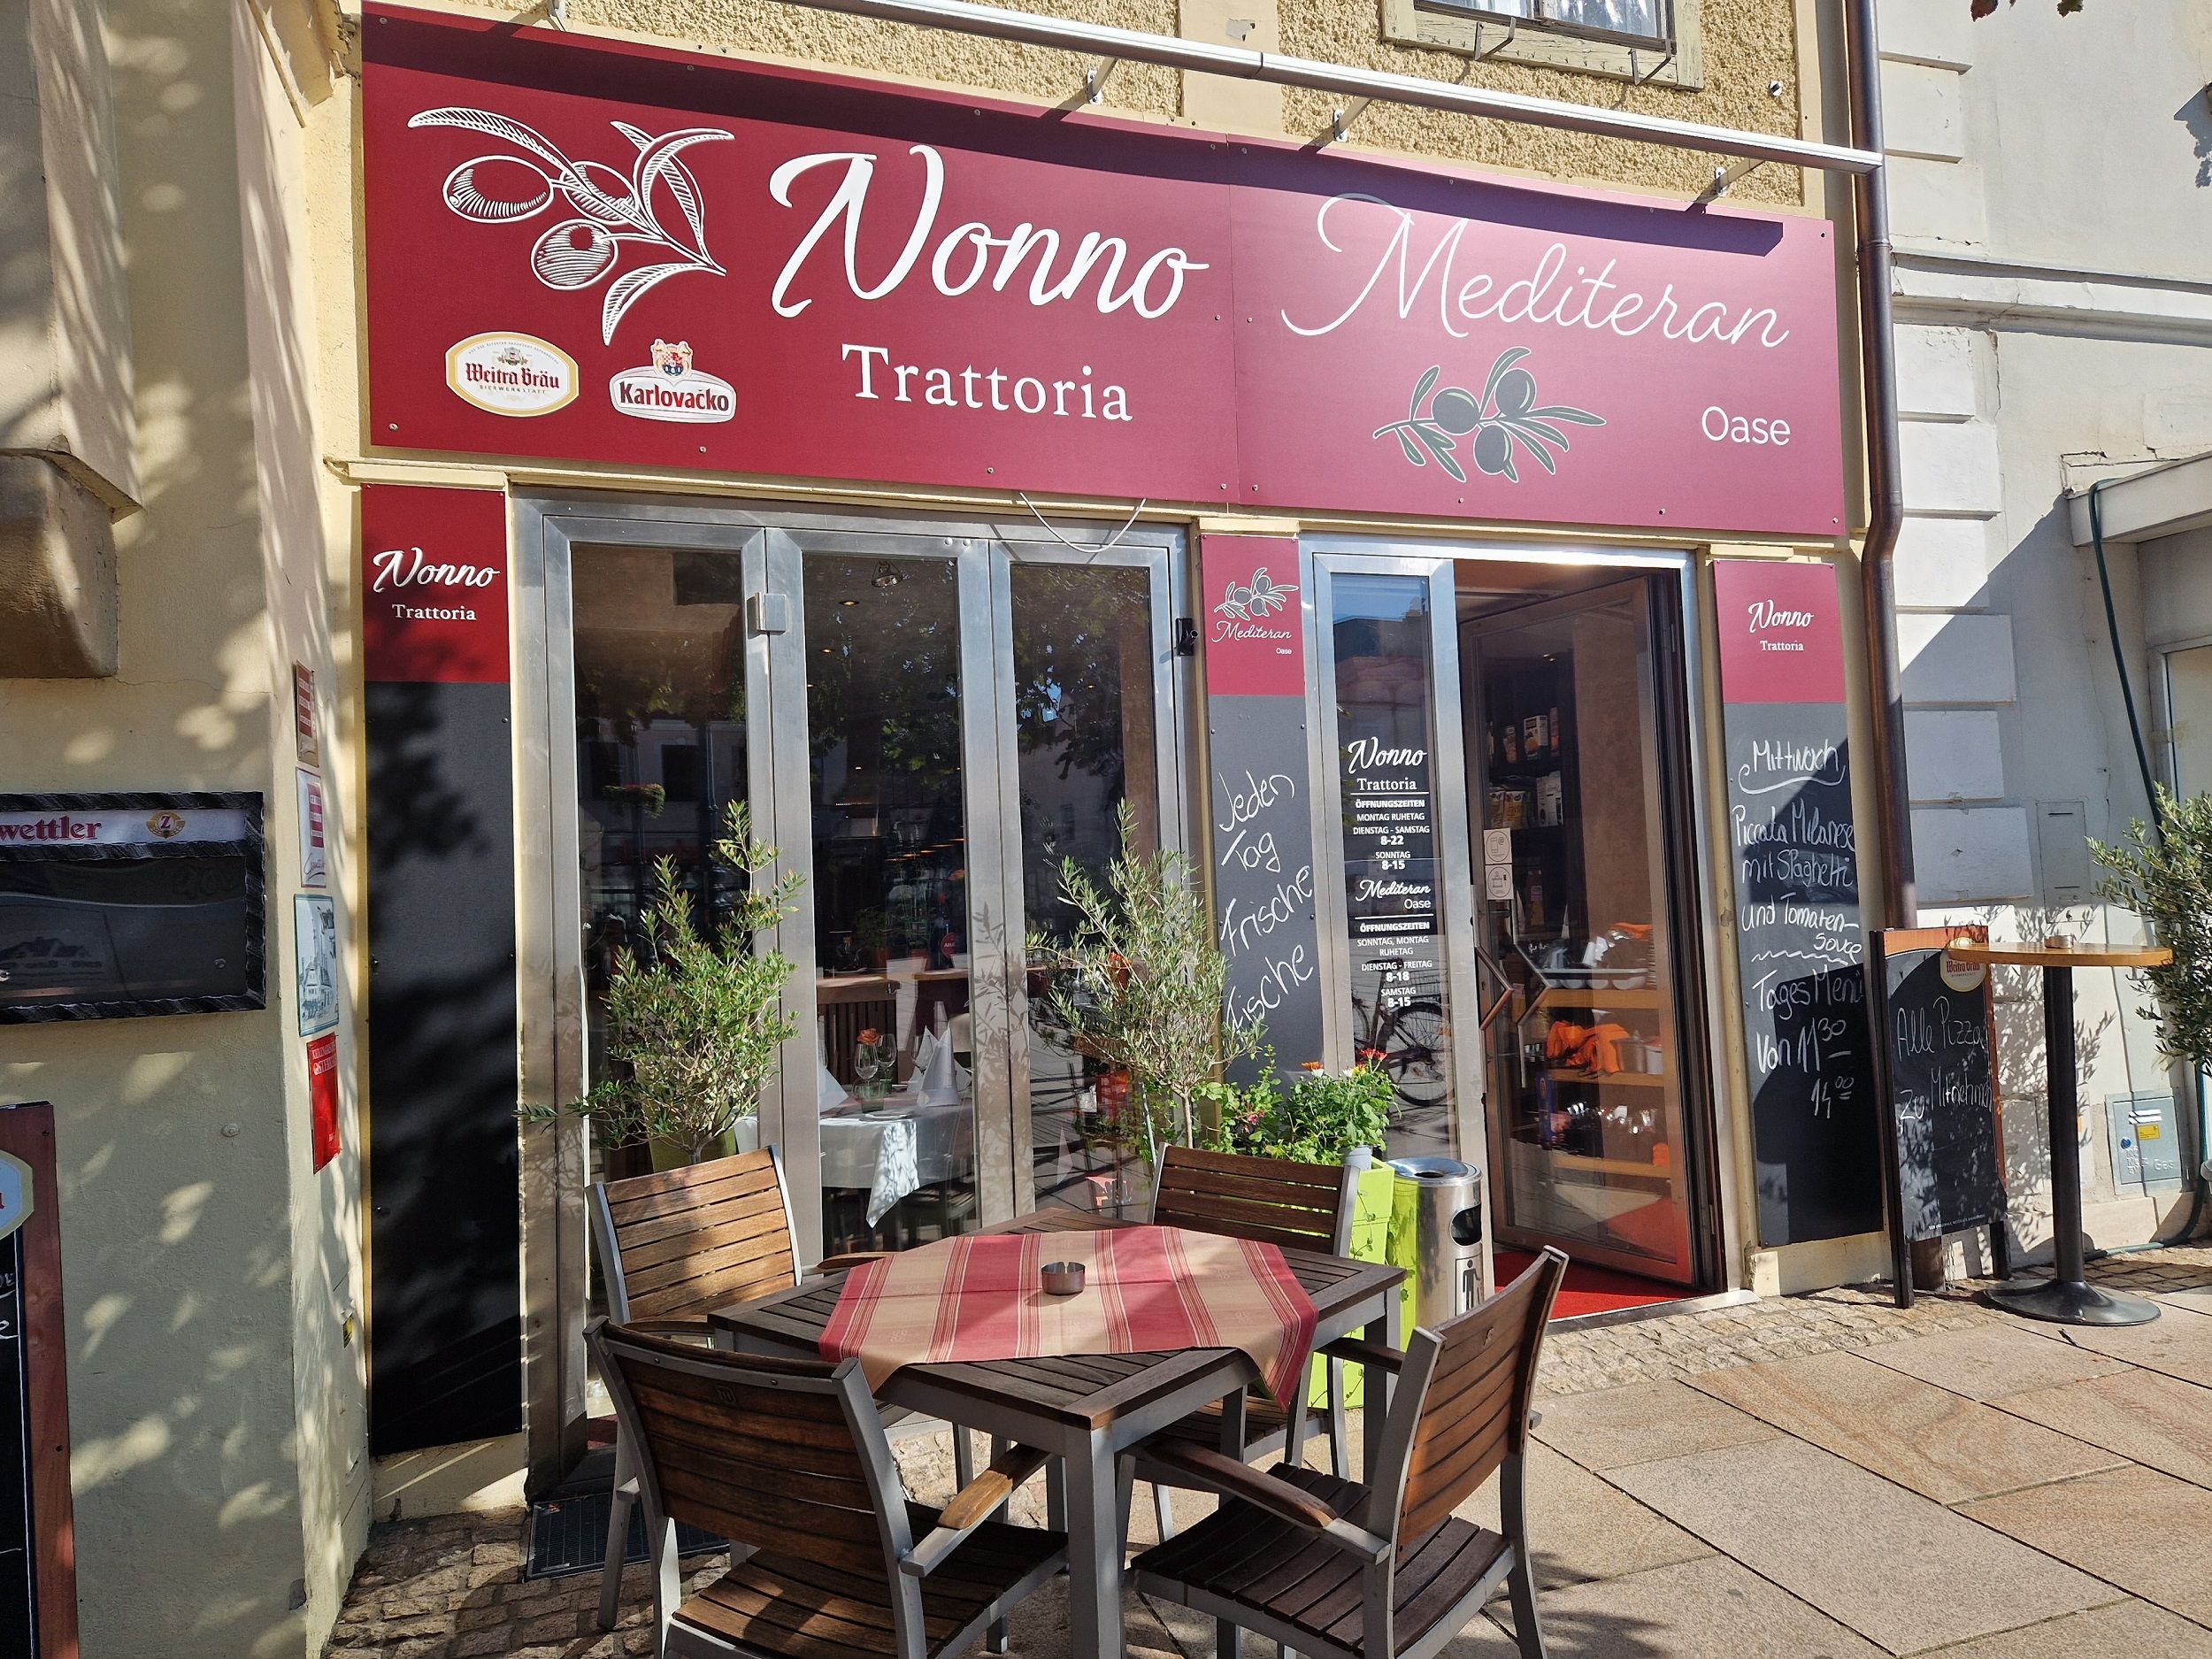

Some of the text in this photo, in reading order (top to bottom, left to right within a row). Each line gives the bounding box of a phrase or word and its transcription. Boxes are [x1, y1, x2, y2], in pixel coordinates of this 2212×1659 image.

[768, 144, 1210, 319] Nonno
[1280, 192, 1790, 349] Mediteran
[465, 362, 560, 390] Weitra Bräu
[841, 342, 1133, 423] Trattoria
[479, 385, 547, 395] BIERWERKSTATT
[619, 381, 730, 412] Karlovačko
[1701, 405, 1791, 447] Oase
[373, 547, 501, 593] Nonno
[392, 603, 477, 621] Trattoria
[1747, 599, 1815, 634] Nonno
[1211, 620, 1292, 642] Mediteran
[1760, 640, 1805, 651] Trattoria
[1348, 736, 1427, 774] Nonno
[1753, 739, 1839, 772] Mittwoch
[1357, 777, 1417, 791] Trattoria
[1217, 770, 1294, 833] Jeden
[1356, 799, 1425, 809] ÖFFNUNGSZEITEN
[1356, 812, 1425, 822] MONTAG RUHETAG
[1353, 826, 1389, 835] DIENSTAG
[1395, 826, 1430, 834] SAMSTAG
[1380, 835, 1404, 846] 8-22
[1221, 829, 1280, 873] Tag
[1375, 850, 1411, 859] SONNTAG
[1381, 860, 1406, 870] 8-15
[1742, 852, 1774, 884] mit
[1356, 879, 1432, 902] Mediteran
[1220, 864, 1313, 956] Frische
[1404, 898, 1432, 910] Oase
[1360, 922, 1431, 933] ÖFFNUNGSZEITEN
[1357, 936, 1429, 948] SONNTAG, MONTAG
[1379, 948, 1414, 956] RUHETAG
[1362, 962, 1398, 972] DIENSTAG
[1403, 960, 1433, 969] FREITAG
[1386, 972, 1410, 983] 8-18
[1380, 987, 1417, 996] SAMSTAG
[1387, 997, 1412, 1008] 8-15
[1897, 1007, 1936, 1062] Alle
[2154, 1158, 2174, 1171] Gas
